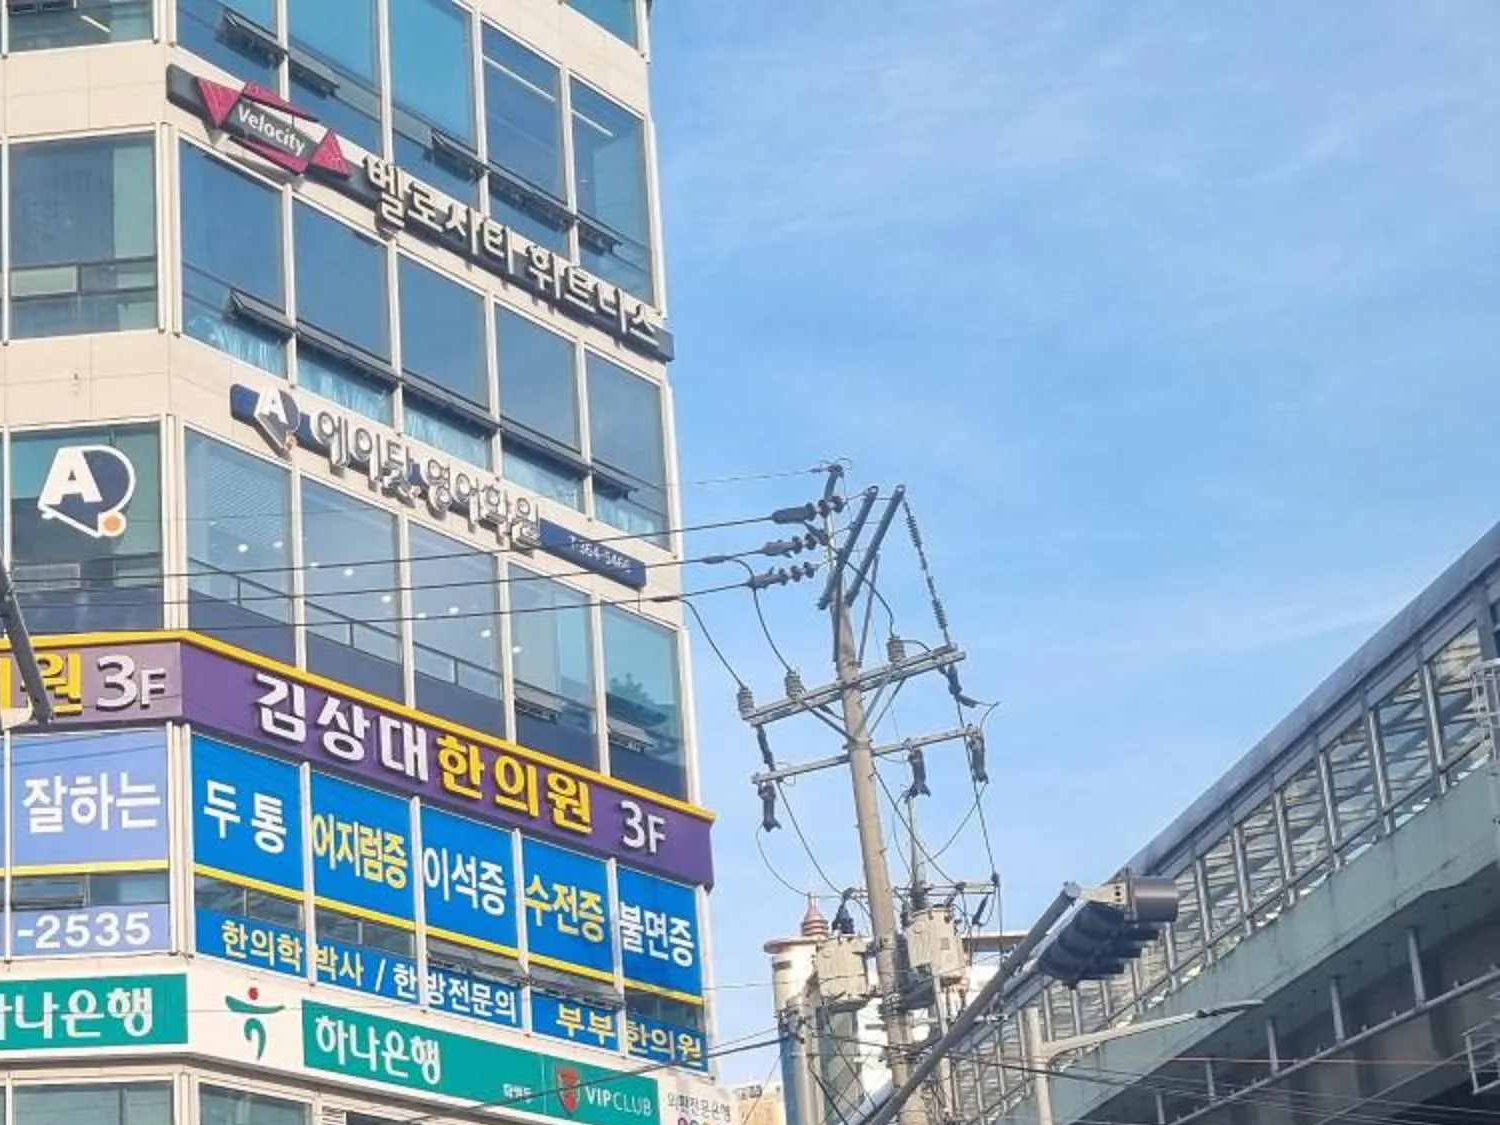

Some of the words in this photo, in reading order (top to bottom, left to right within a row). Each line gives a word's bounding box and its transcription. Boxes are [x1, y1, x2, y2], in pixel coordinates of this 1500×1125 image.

[234, 101, 306, 157] Velocity
[528, 244, 660, 347] 휘트니스
[96, 653, 167, 712] 3F
[21, 771, 162, 835] 잘하는
[202, 778, 289, 856] 두통
[618, 800, 670, 854] 3F
[311, 812, 409, 890] 어지럼증
[423, 847, 508, 916] 이석증
[522, 873, 606, 943] 수전증
[618, 899, 695, 968] 불면증
[314, 1011, 442, 1087] 하나은행
